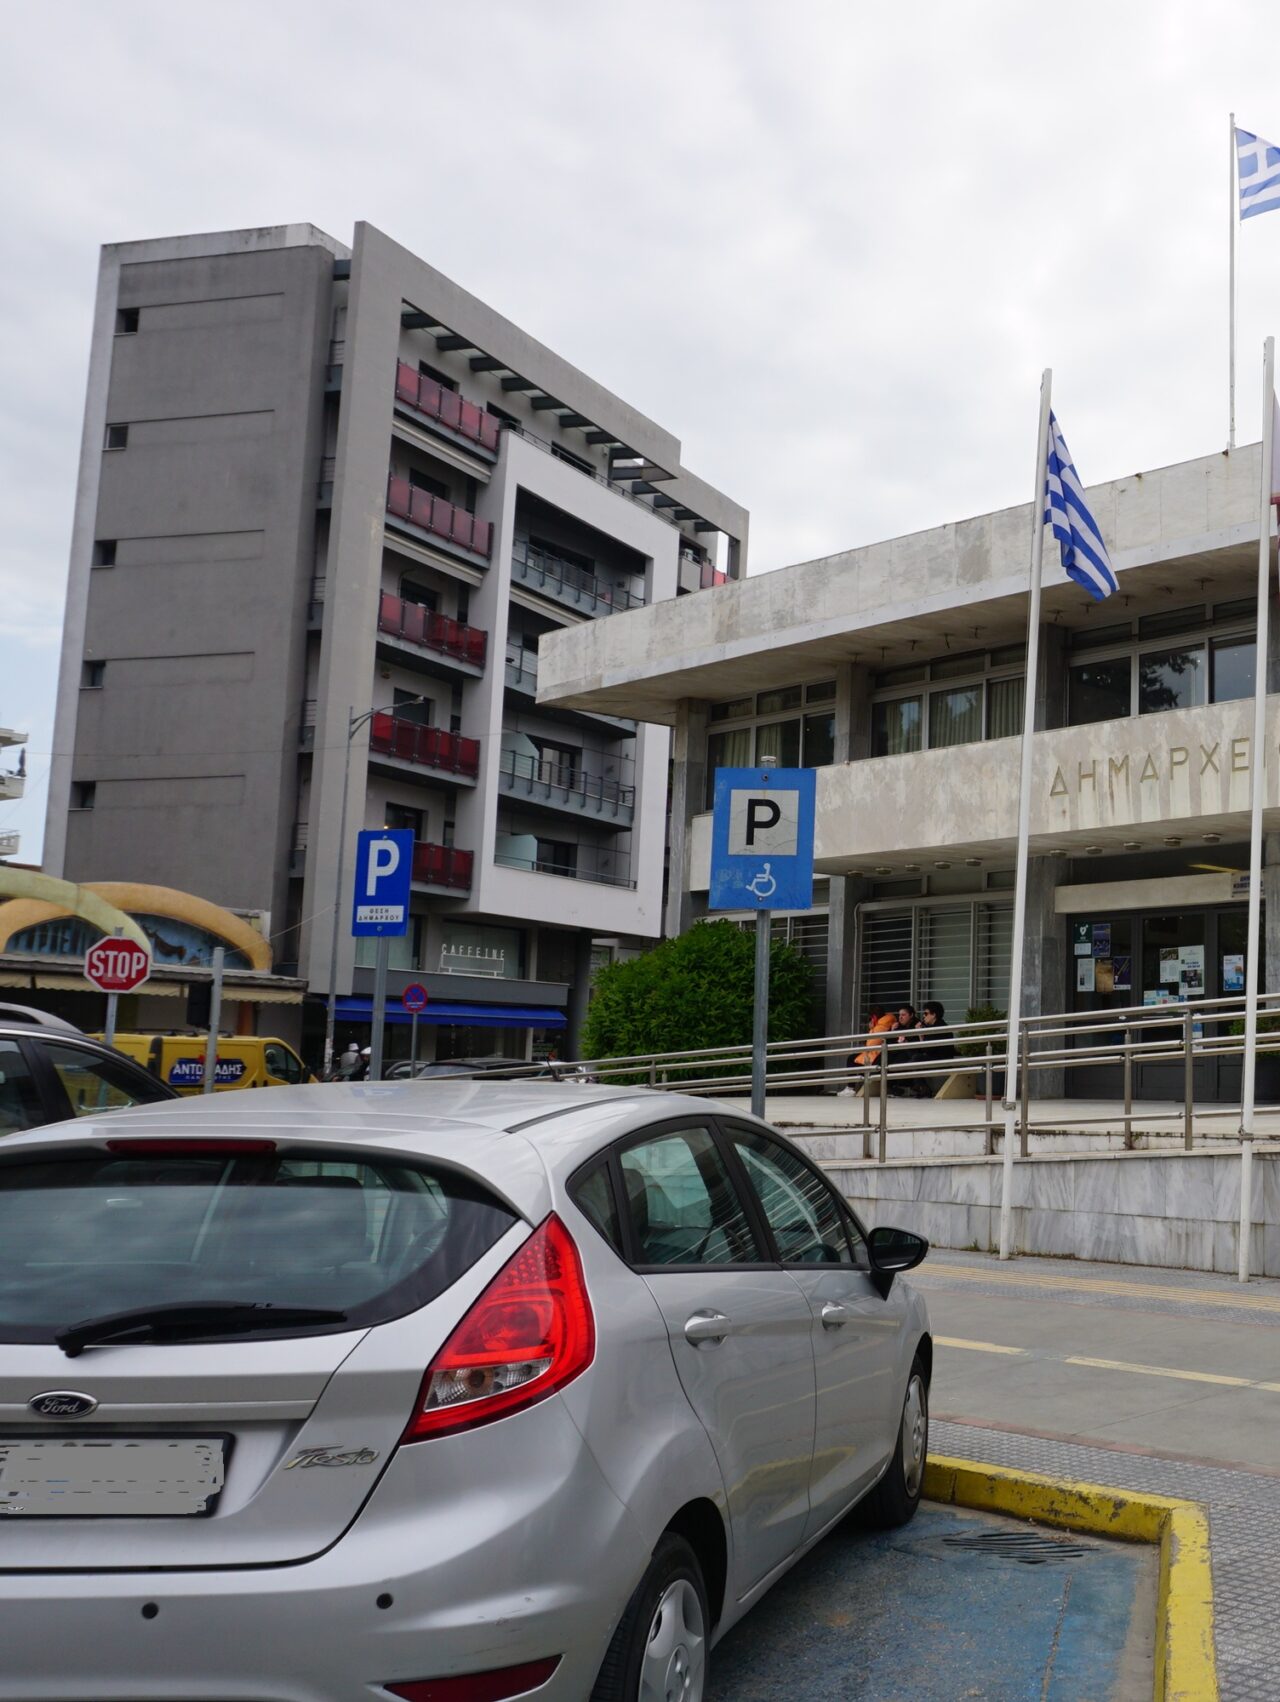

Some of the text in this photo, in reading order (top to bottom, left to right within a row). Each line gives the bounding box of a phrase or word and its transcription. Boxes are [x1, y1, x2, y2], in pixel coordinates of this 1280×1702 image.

[745, 798, 781, 846] P
[366, 839, 400, 896] P
[90, 950, 146, 979] STOP
[441, 943, 505, 960] CAFFEINE
[173, 1063, 243, 1075] ΑΝΤΩΑΔΗΣ
[40, 1396, 81, 1415] Ford
[283, 1444, 380, 1472] Fiesta
